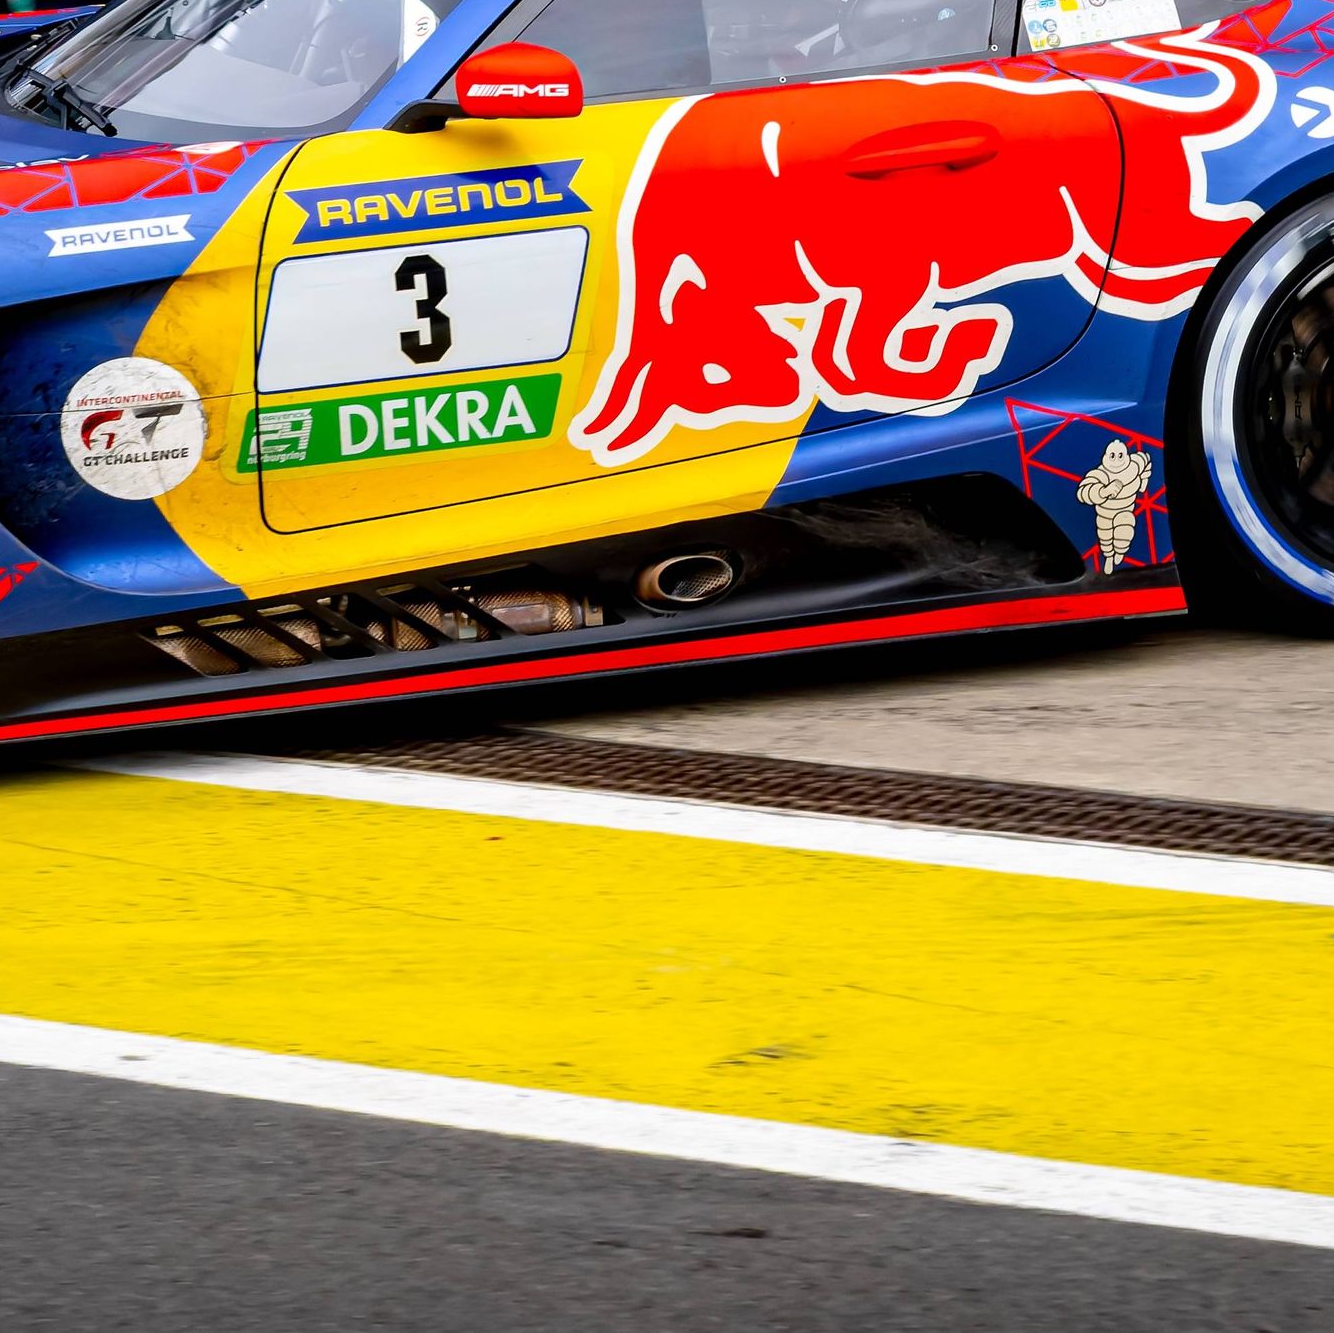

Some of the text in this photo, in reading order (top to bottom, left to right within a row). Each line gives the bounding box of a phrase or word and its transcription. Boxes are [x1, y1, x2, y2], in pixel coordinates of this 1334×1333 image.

[497, 83, 570, 98] AMG
[317, 176, 564, 228] RAVENOL
[61, 223, 180, 251] RAVENOL
[394, 254, 452, 365] 3
[75, 389, 184, 408] INTERCONTINENTAL
[337, 383, 537, 457] DEKRA
[83, 447, 190, 468] GT CHALLENGE
